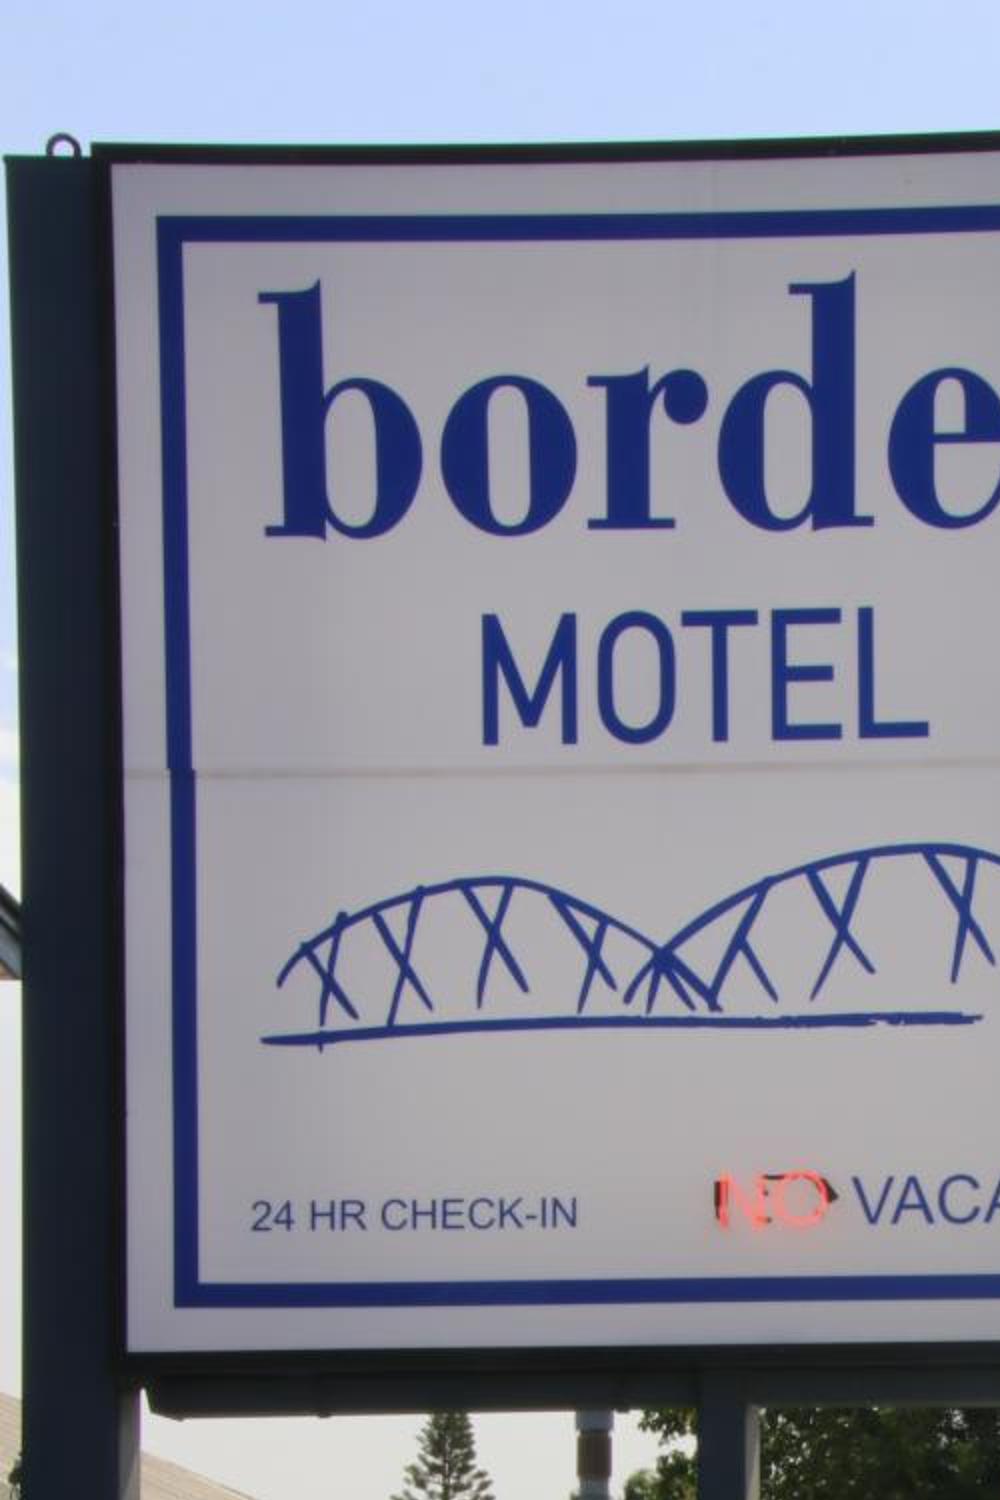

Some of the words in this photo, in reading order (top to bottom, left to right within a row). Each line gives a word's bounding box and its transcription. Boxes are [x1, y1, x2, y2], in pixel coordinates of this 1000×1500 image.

[482, 607, 930, 747] MOTEL
[252, 1199, 296, 1232] 24
[309, 1199, 367, 1231] HR
[380, 1197, 578, 1231] CHECK-IN
[714, 1171, 838, 1228] NO
